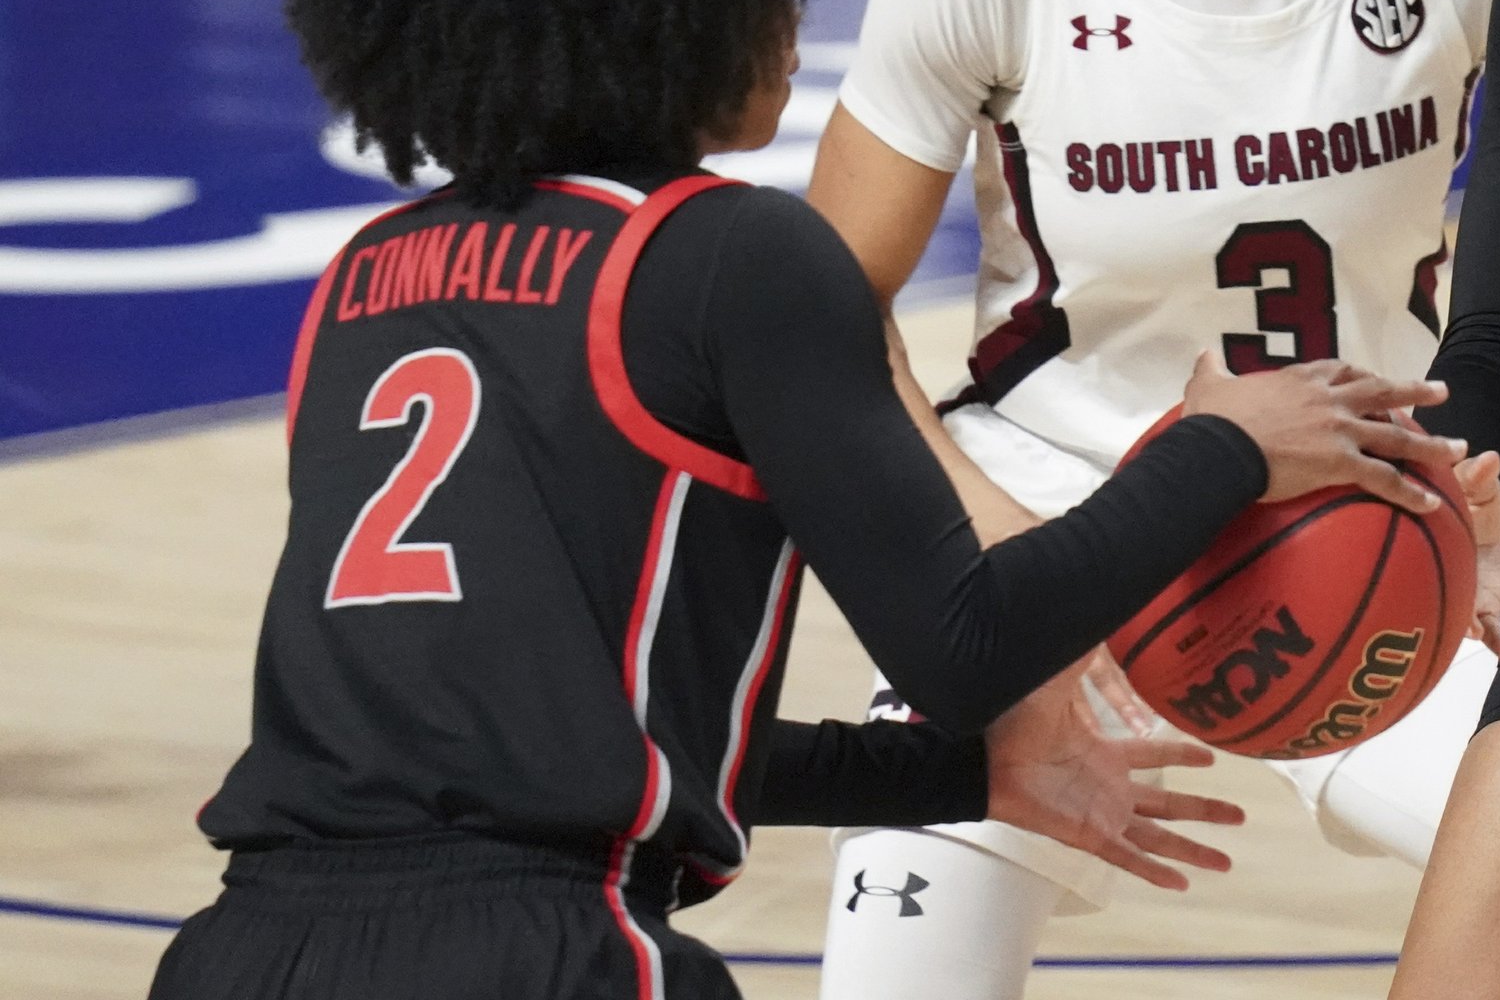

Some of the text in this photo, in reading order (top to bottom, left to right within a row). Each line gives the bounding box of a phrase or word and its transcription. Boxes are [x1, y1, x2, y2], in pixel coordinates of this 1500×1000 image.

[1066, 96, 1439, 194] SOUTH CAROLINA
[337, 221, 594, 322] CONNALLY
[1215, 219, 1340, 376] 3
[323, 346, 483, 610] 2
[1168, 605, 1316, 730] NCAA
